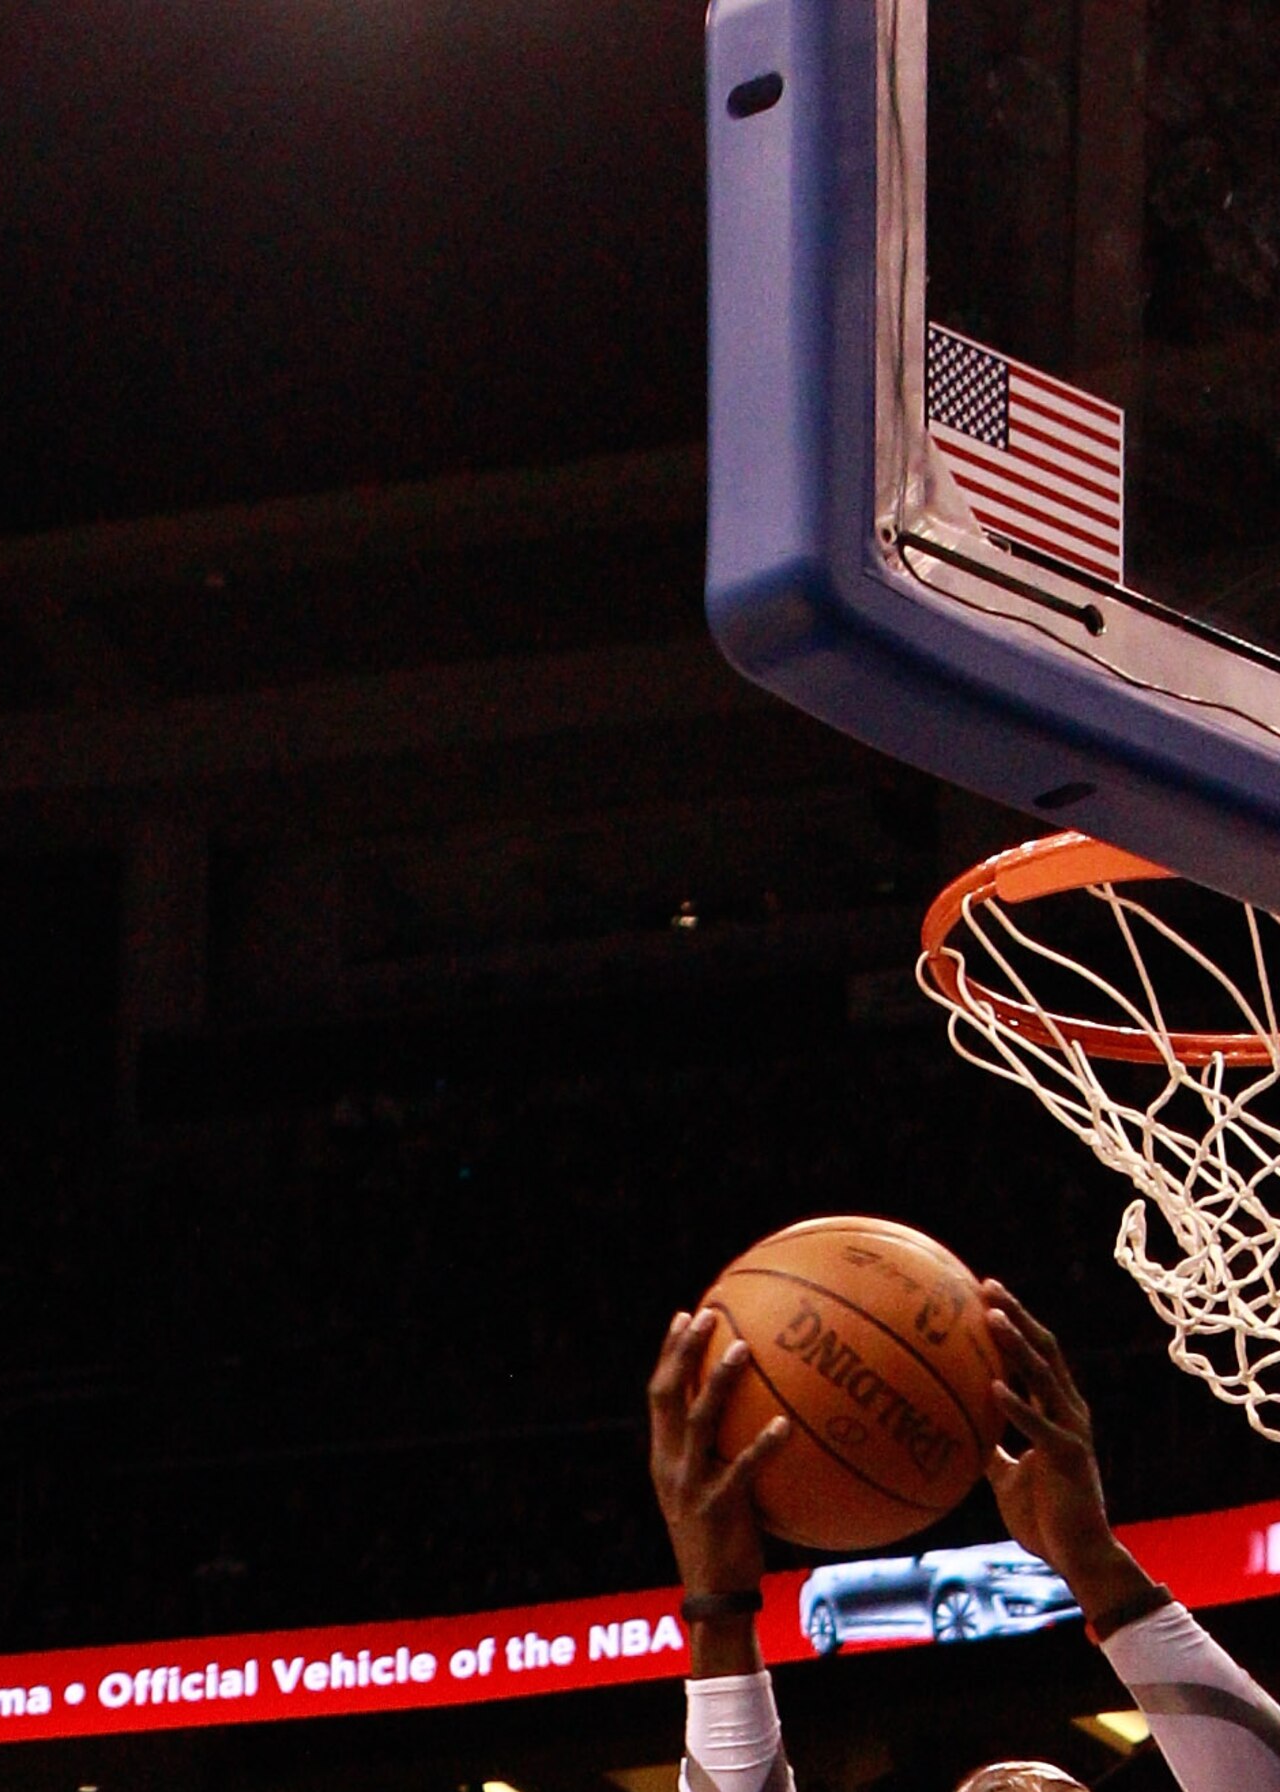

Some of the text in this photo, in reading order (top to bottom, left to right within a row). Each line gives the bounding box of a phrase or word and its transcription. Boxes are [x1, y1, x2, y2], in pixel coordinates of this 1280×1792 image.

[97, 1659, 258, 1708] Official
[270, 1636, 438, 1695] Vehicle
[449, 1637, 495, 1679] of
[505, 1632, 576, 1672] the
[588, 1615, 684, 1661] NBA
